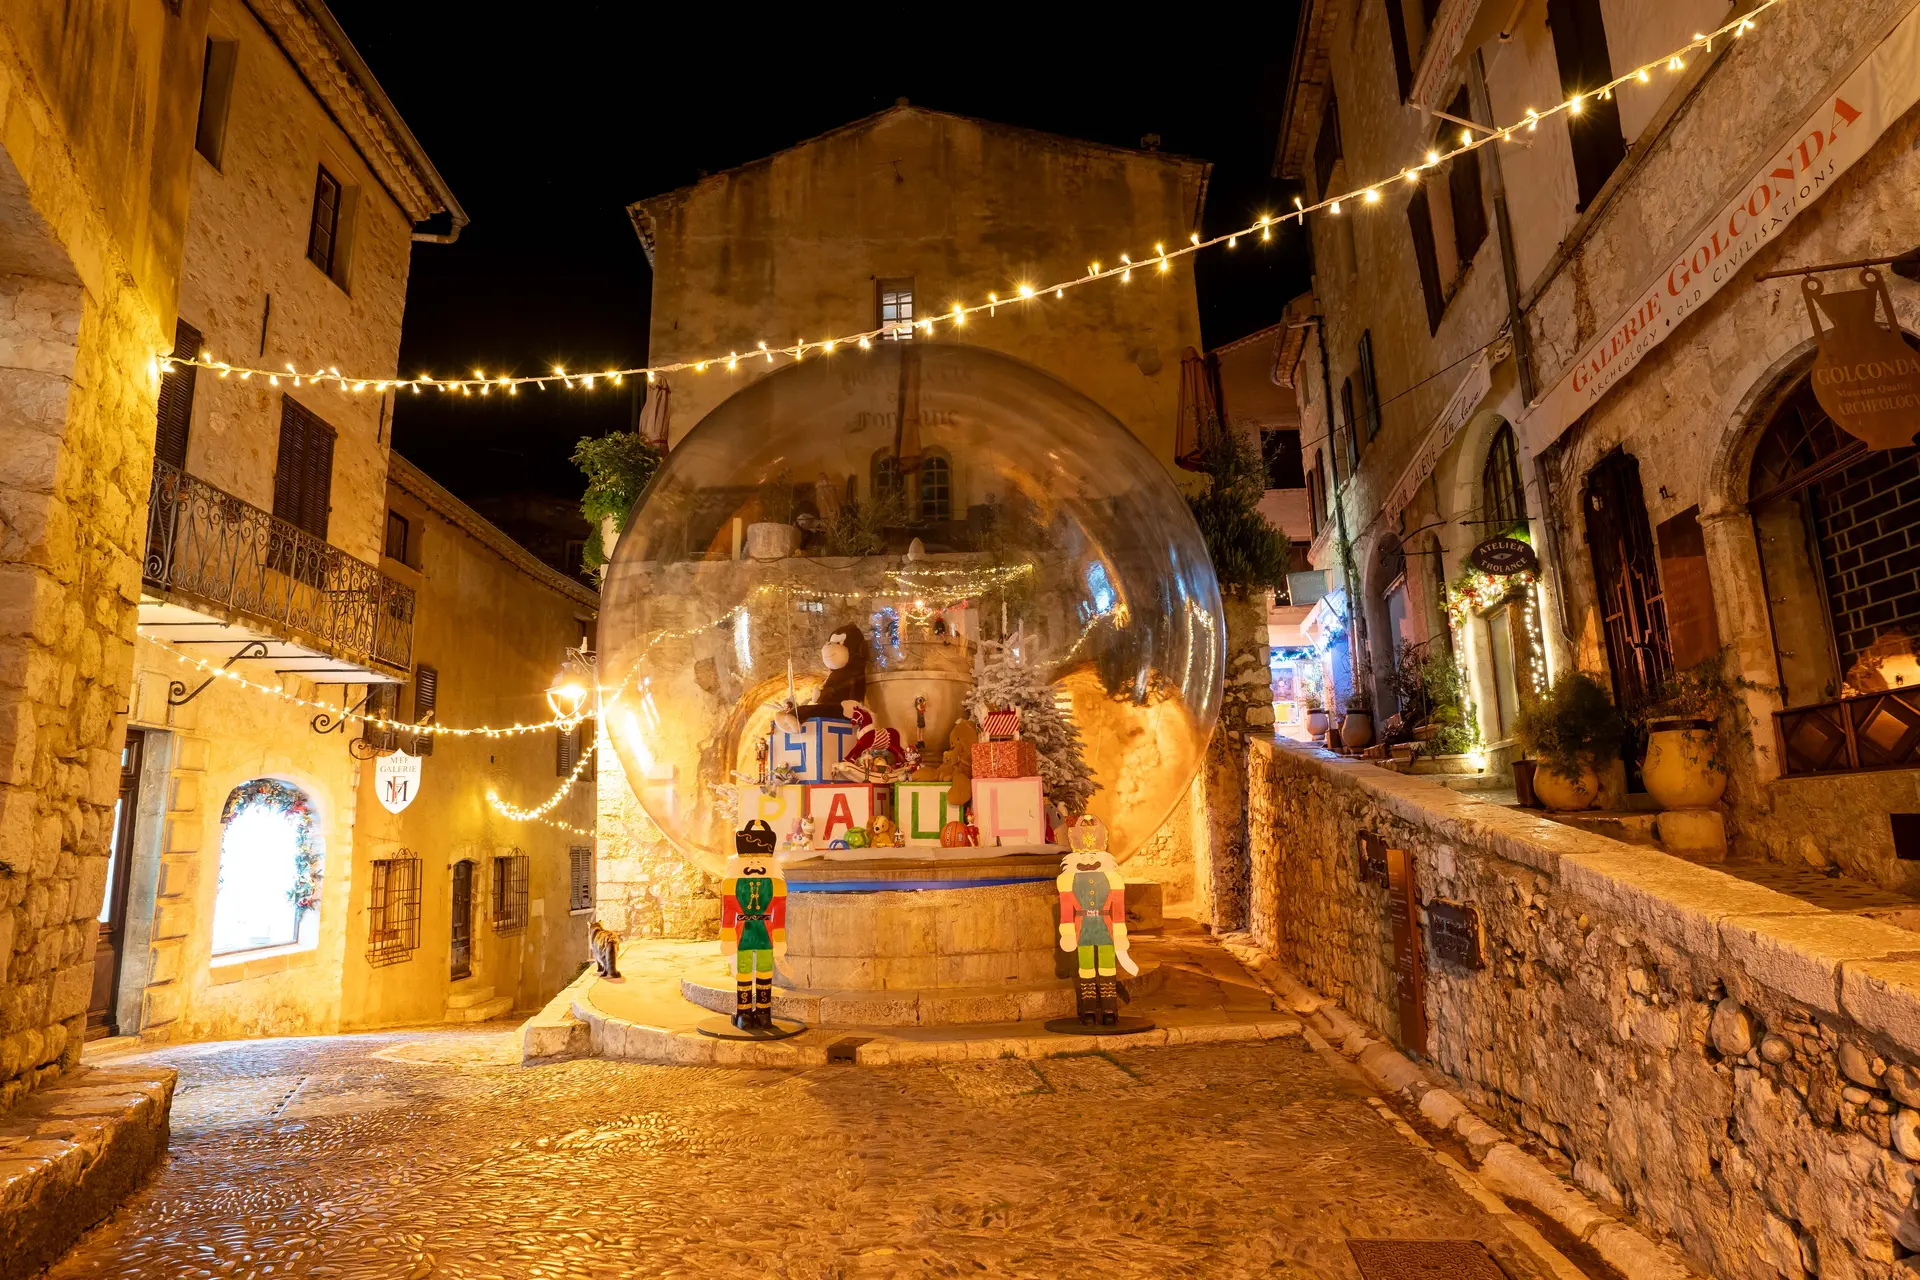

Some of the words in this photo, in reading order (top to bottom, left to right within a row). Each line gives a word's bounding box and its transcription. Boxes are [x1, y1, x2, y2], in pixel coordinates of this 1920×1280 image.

[1572, 292, 1662, 393] GALERIE
[1667, 97, 1863, 297] GOLCONDA
[1589, 329, 1657, 400] ARCHEOLOGY
[1677, 289, 1701, 316] OLD
[1713, 159, 1834, 283] CIVILISATIONS
[1817, 357, 1920, 385] GOLCONDA
[1480, 541, 1525, 556] ATELIER
[1480, 556, 1528, 572] THOLANCE
[380, 765, 417, 773] GALERIE
